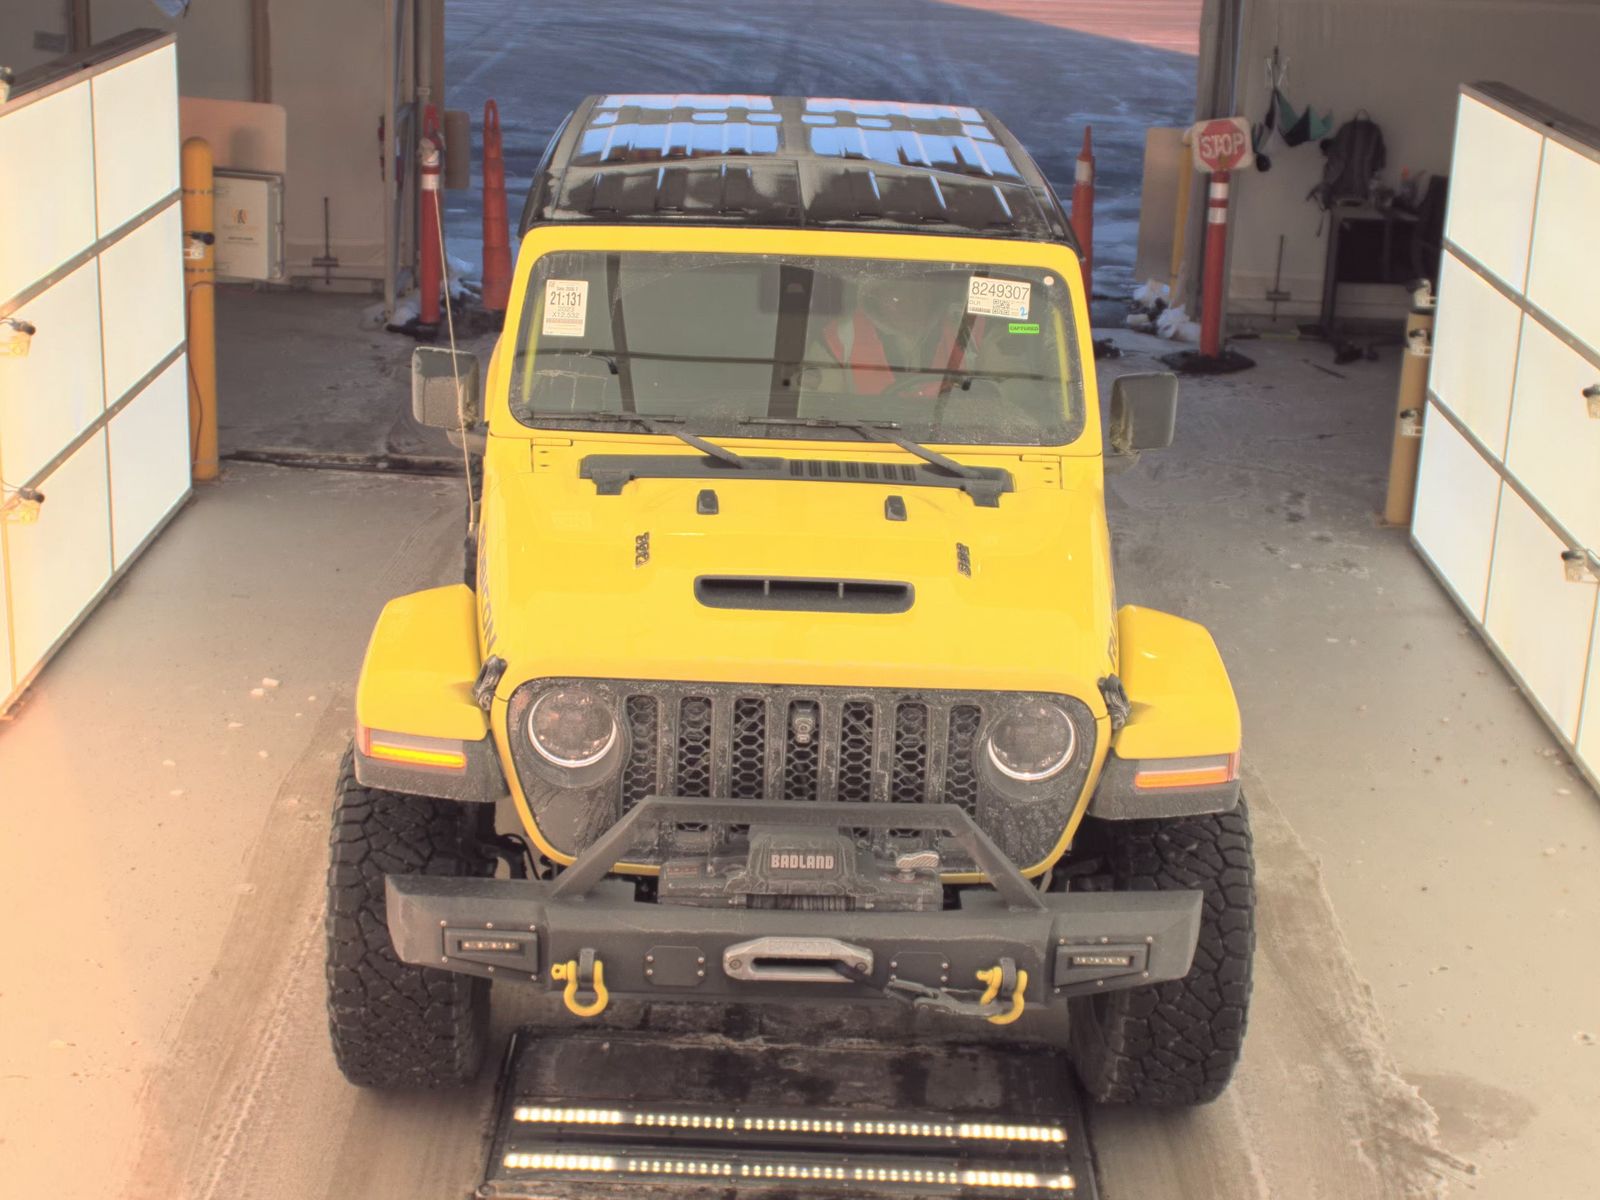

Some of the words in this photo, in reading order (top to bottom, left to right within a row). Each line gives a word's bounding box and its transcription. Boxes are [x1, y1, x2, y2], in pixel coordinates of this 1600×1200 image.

[1200, 133, 1244, 159] STOP
[550, 291, 582, 306] 21:131
[971, 281, 1030, 300] 8249307
[771, 855, 834, 869] BADLAND
